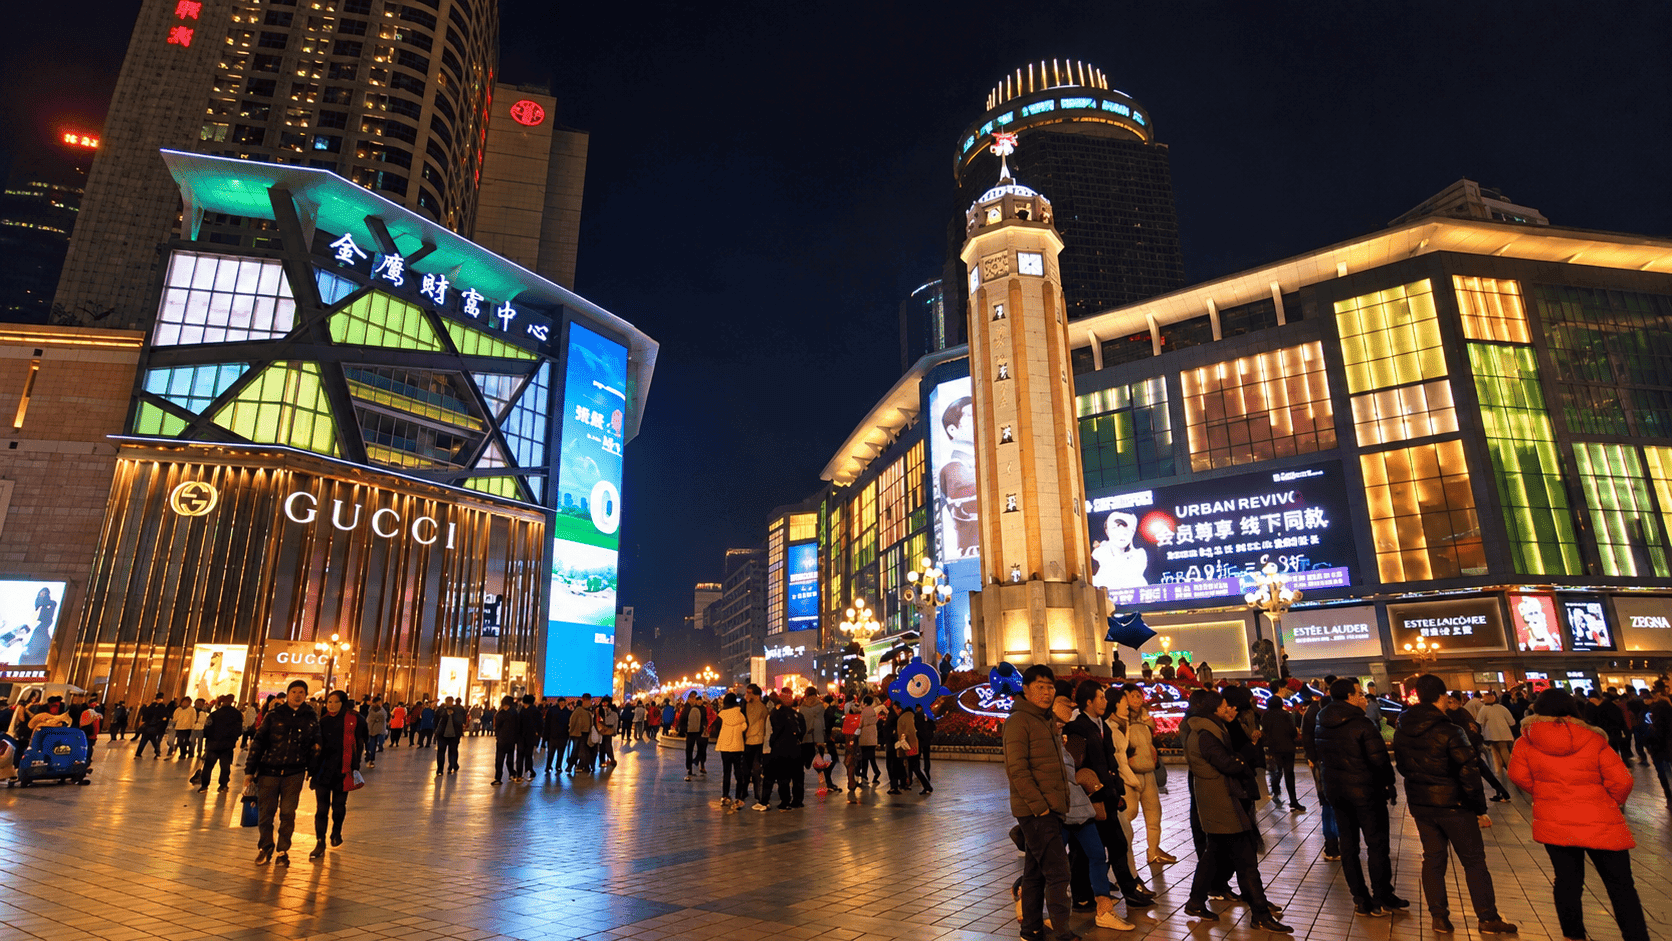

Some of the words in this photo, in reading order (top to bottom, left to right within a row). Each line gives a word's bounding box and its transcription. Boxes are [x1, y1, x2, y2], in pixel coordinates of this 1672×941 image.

[1175, 499, 1235, 518] URBAN
[284, 491, 457, 549] GUCCI
[1156, 519, 1235, 546] 会员尊享
[1240, 506, 1329, 535] 线下同款
[1323, 623, 1369, 635] LAUDER
[1629, 616, 1671, 628] ZEGNA
[276, 652, 338, 665] GUCCI
